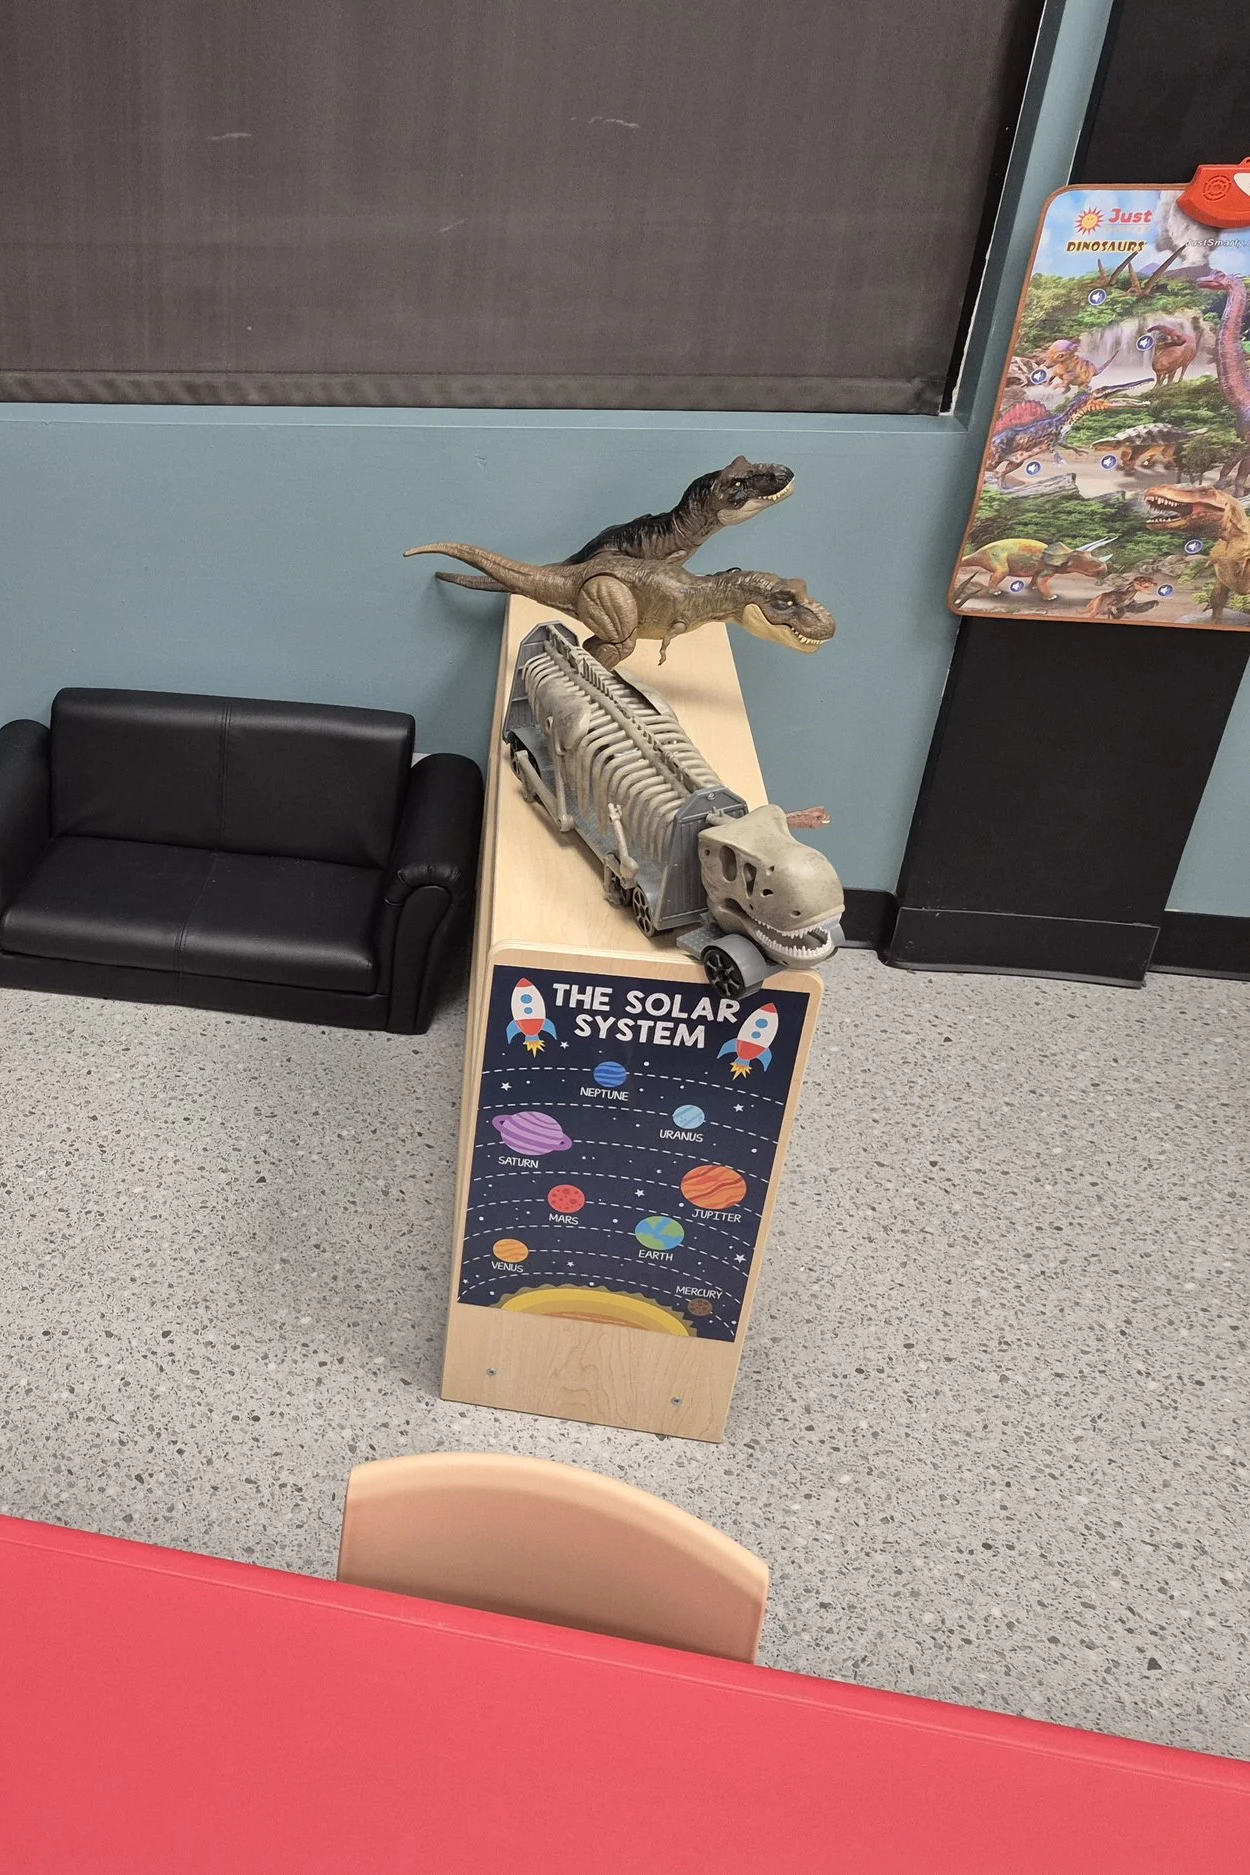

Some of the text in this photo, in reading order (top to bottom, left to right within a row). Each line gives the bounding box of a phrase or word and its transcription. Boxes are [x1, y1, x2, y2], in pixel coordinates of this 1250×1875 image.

[1108, 208, 1152, 224] Just
[1066, 240, 1145, 252] DINOSAURS
[552, 983, 741, 1024] THE SOLAR
[573, 1014, 706, 1049] SYSTEM
[579, 1086, 630, 1102] NEPTUNE
[659, 1128, 704, 1143] URANUS
[498, 1155, 539, 1169] SATURN
[548, 1213, 579, 1226] MARS
[691, 1208, 742, 1224] JUPITER
[638, 1249, 673, 1262] EARTH
[491, 1260, 525, 1274] VENUS
[675, 1285, 723, 1300] MERCURY
